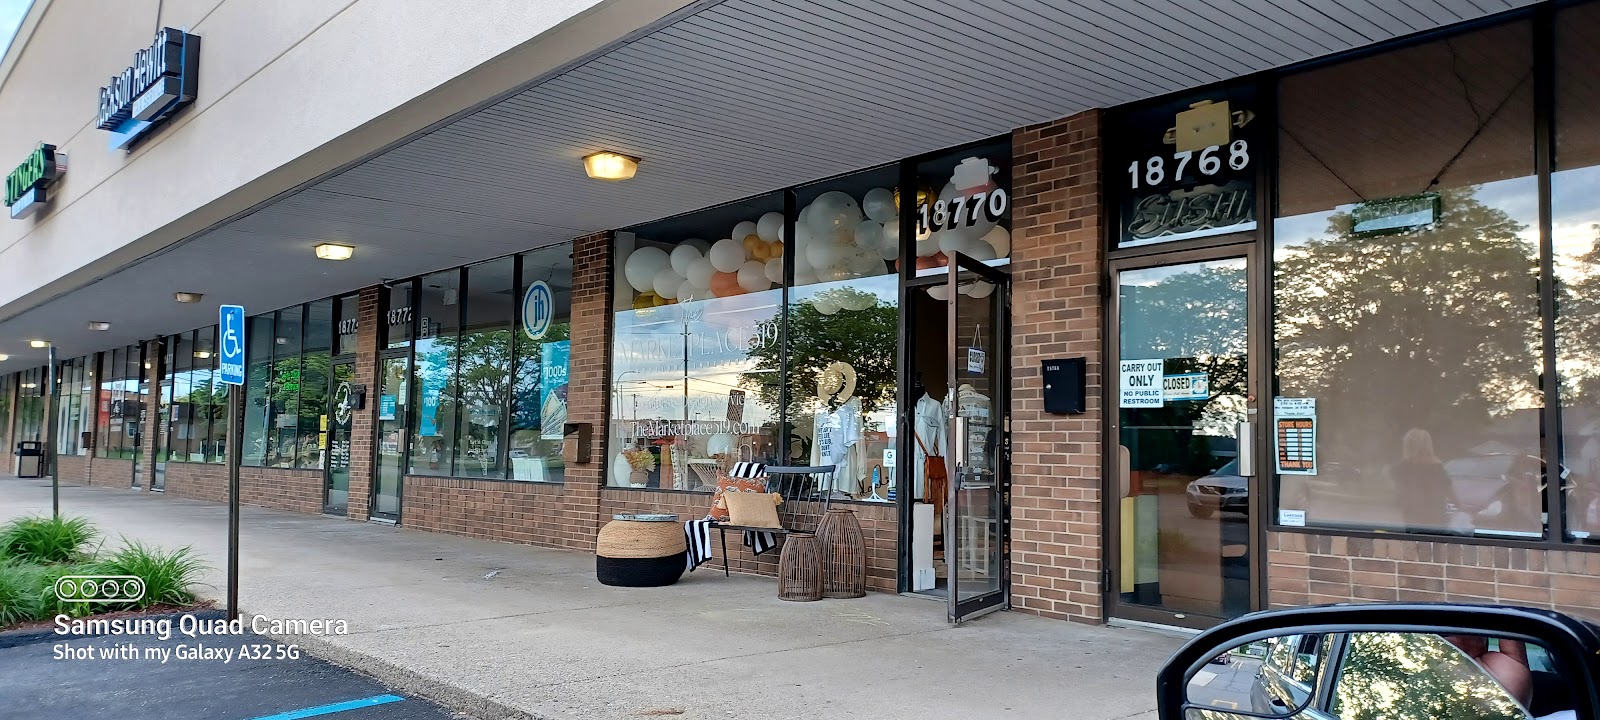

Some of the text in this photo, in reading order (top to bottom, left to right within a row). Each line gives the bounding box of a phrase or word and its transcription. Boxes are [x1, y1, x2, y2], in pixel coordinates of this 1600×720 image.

[1128, 139, 1250, 189] 18768
[4, 143, 45, 207] STINGERS
[920, 188, 1007, 229] 18770
[1128, 189, 1248, 236] SUSHI
[222, 362, 242, 377] PARKING
[1122, 363, 1162, 372] CARRY OUT
[1129, 374, 1154, 387] ONLY
[1163, 377, 1190, 390] CLOSED
[630, 419, 760, 438] TheMarketplace519.com
